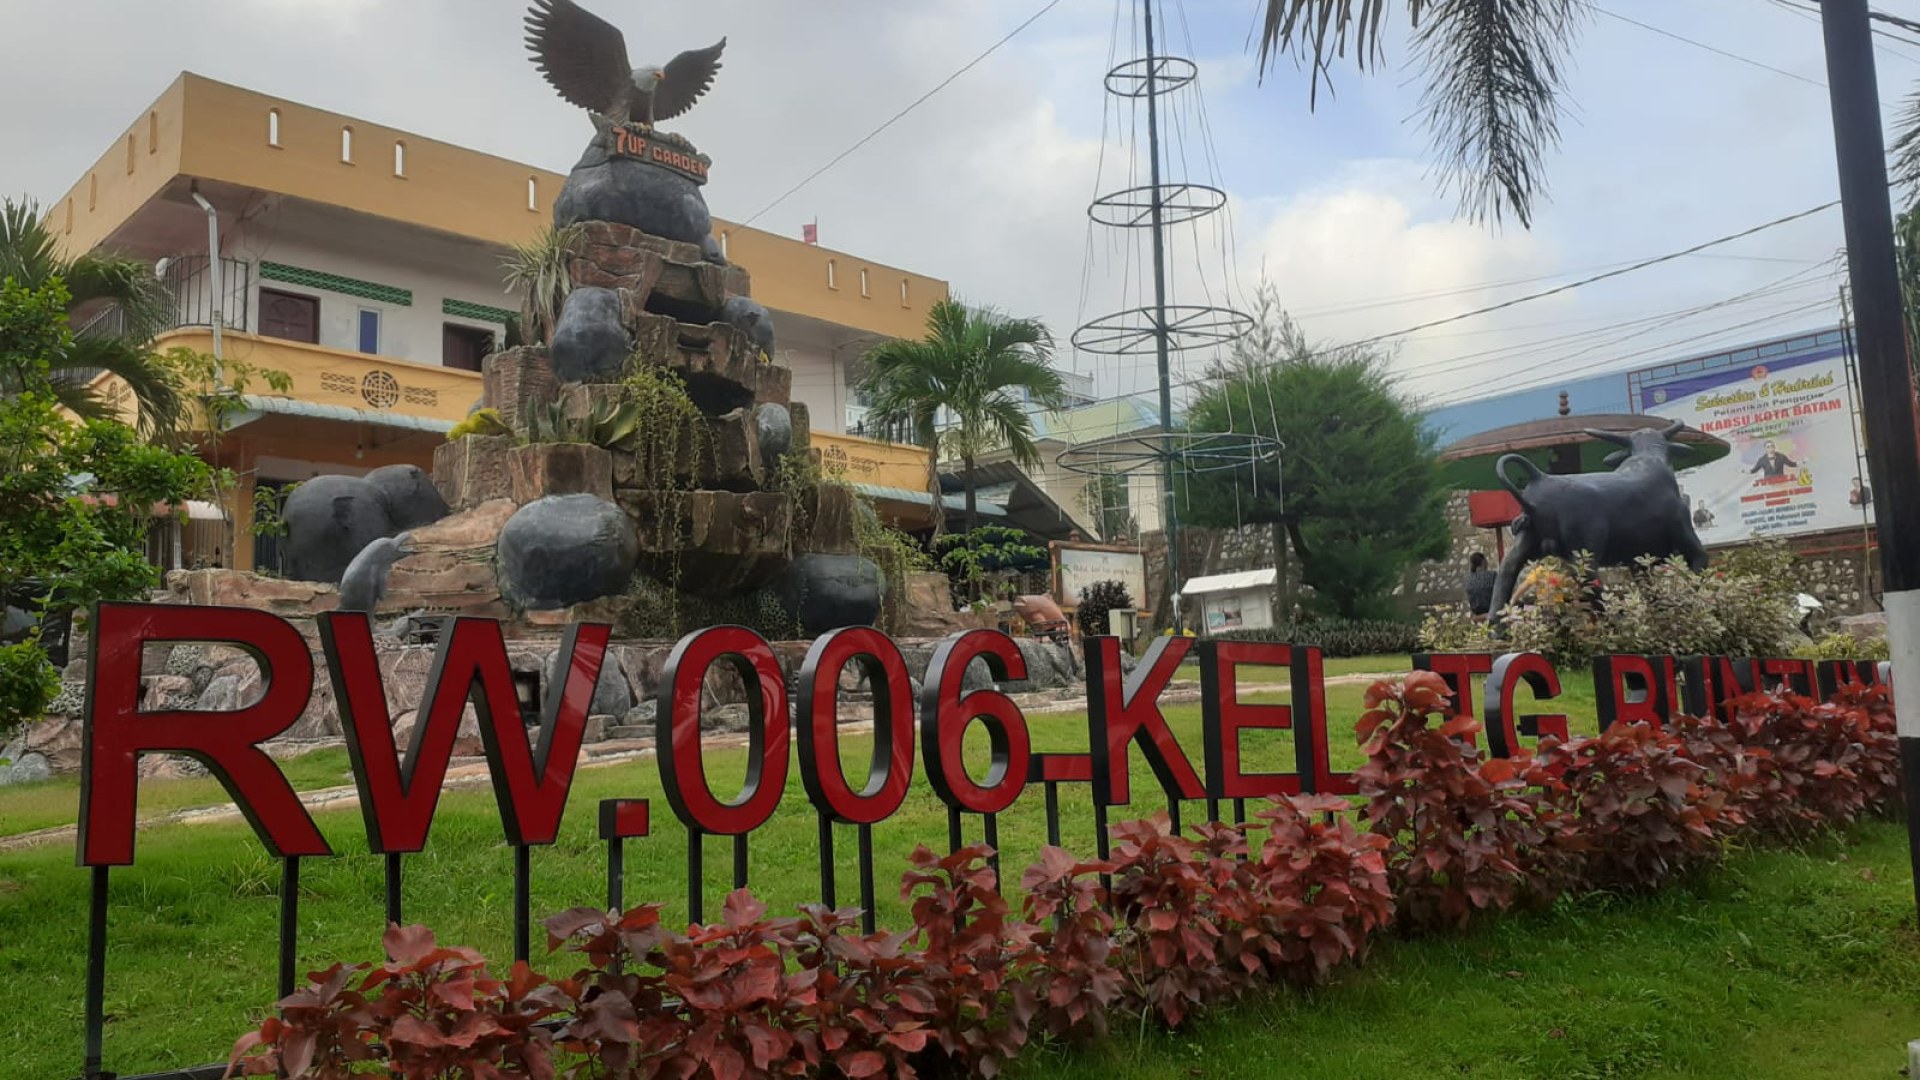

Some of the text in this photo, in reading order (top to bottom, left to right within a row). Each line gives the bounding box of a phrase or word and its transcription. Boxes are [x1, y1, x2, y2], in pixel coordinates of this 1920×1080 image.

[611, 126, 709, 177] 7UP GARDEN
[1754, 407, 1790, 424] KOTA
[1793, 398, 1842, 417] BATAM
